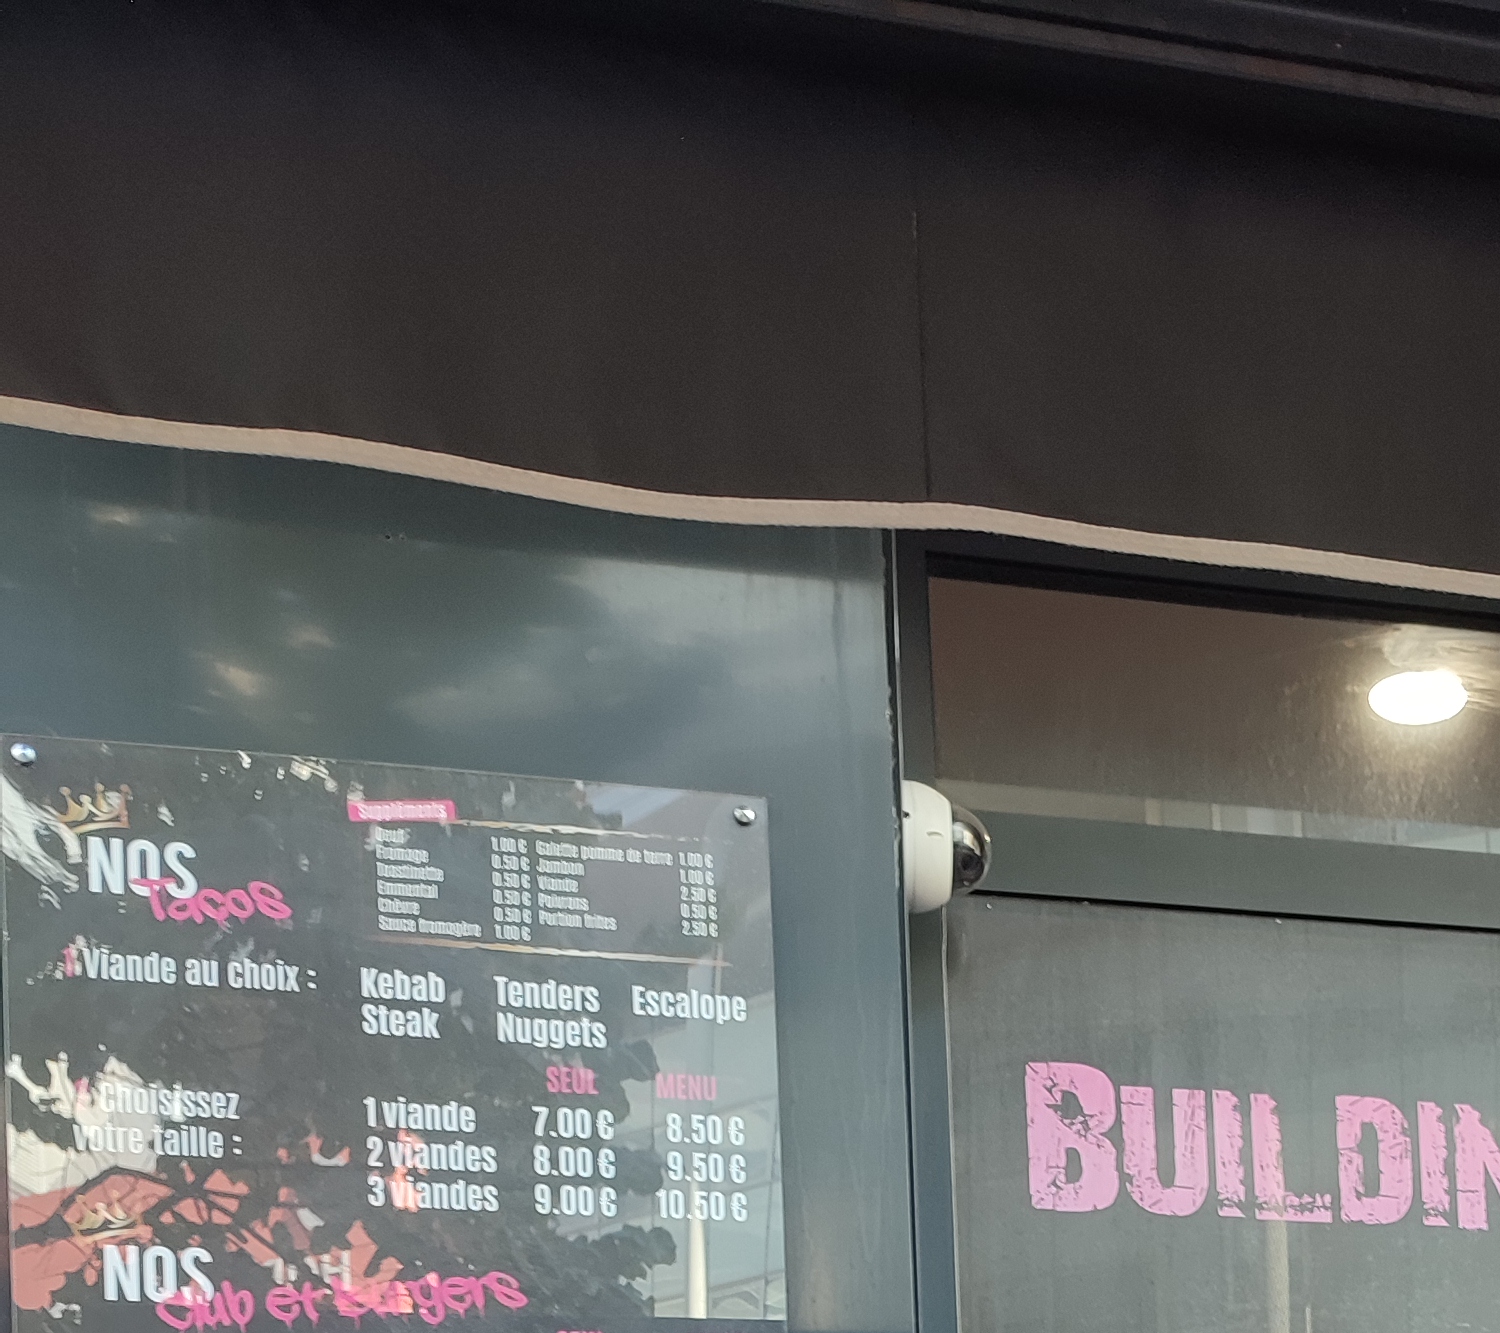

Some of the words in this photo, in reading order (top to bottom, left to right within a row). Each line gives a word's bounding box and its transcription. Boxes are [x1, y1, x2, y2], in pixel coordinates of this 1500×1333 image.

[86, 835, 198, 898] NOS
[130, 877, 292, 924] Tacos
[81, 946, 177, 984] Viande
[185, 961, 219, 988] au
[359, 966, 446, 1003] Kebab
[493, 974, 601, 1013] Tenders
[631, 984, 748, 1024] Escalope
[361, 1003, 441, 1039] Steak
[496, 1010, 608, 1050] Nuggets
[100, 1080, 241, 1121] Choisissez
[546, 1066, 599, 1095] SEUL
[655, 1071, 718, 1101] MENU
[72, 1124, 144, 1153] votre
[103, 1244, 215, 1303] NOS
